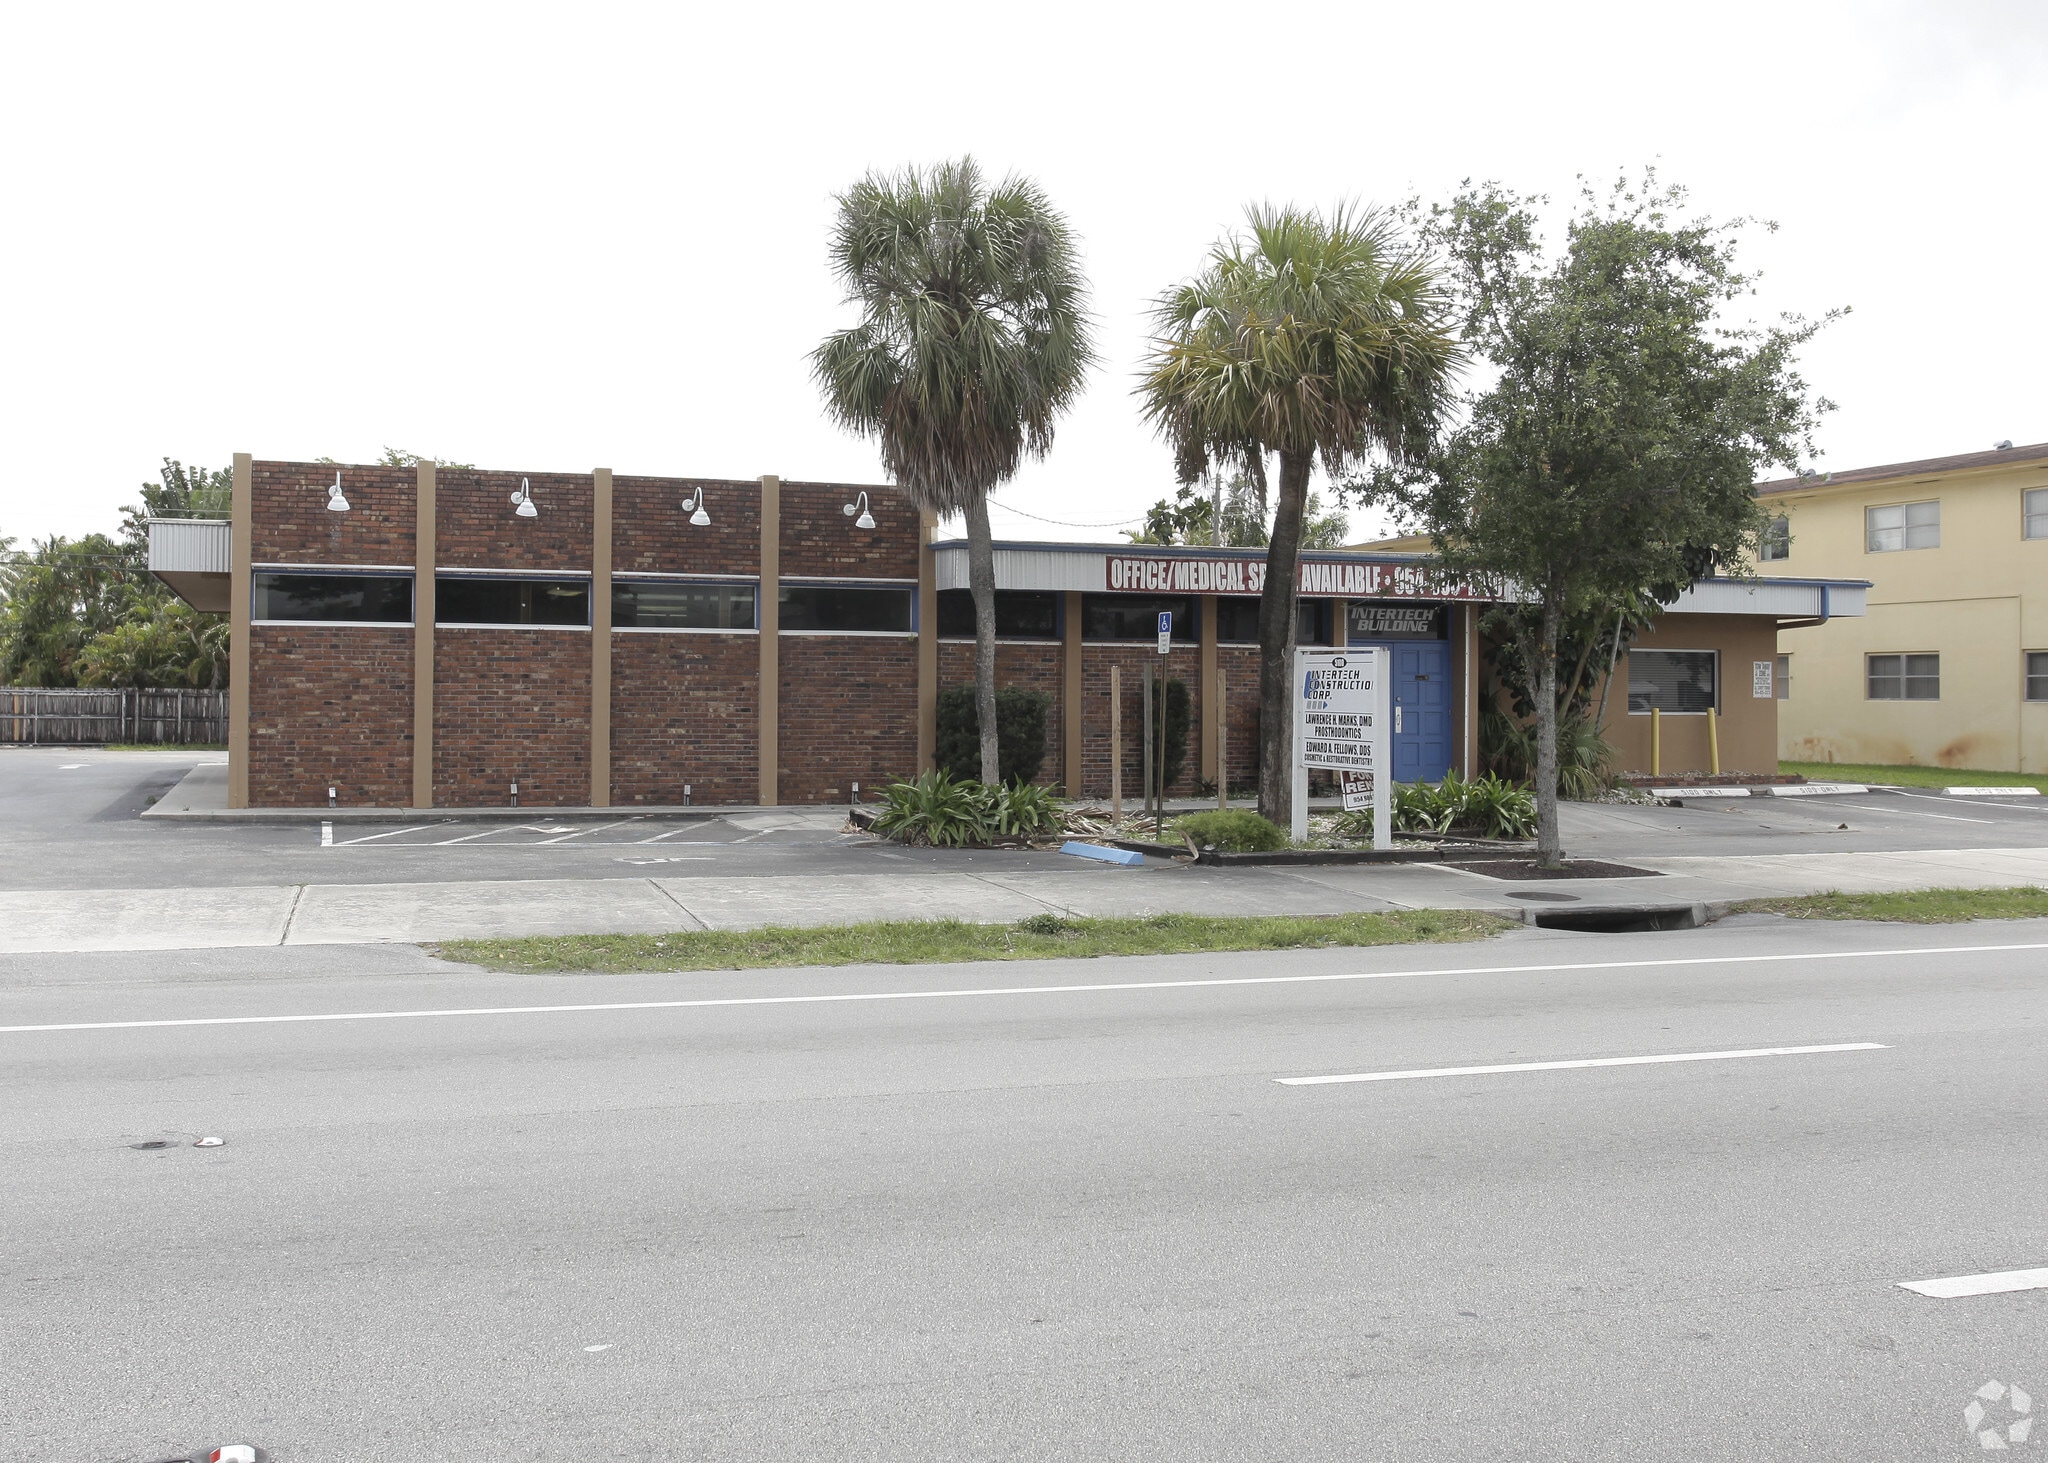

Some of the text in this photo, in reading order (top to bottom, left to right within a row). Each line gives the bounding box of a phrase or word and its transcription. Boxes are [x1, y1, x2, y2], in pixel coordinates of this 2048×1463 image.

[1111, 558, 1245, 591] OFFICE/MEDICAL
[1301, 564, 1380, 593] AVAILABLE
[1351, 607, 1434, 620] INTERTECH
[1357, 619, 1429, 632] BUILDING
[1311, 670, 1360, 679] INTERTECH
[1307, 690, 1332, 700] CORP.
[1305, 713, 1373, 727] LAWRENCE H. MARKS, DMD
[1314, 727, 1362, 738] PROSTHODONTICS
[1306, 742, 1327, 754] EDWARD
[1333, 743, 1358, 757] FELLOWS,
[1359, 744, 1372, 757] DDS
[1304, 753, 1323, 762] COSMETIC
[1326, 755, 1351, 764] RESTORATIVE
[1351, 757, 1373, 766] DENTISTRY
[1348, 771, 1373, 781] FOR
[1345, 780, 1374, 794] REN
